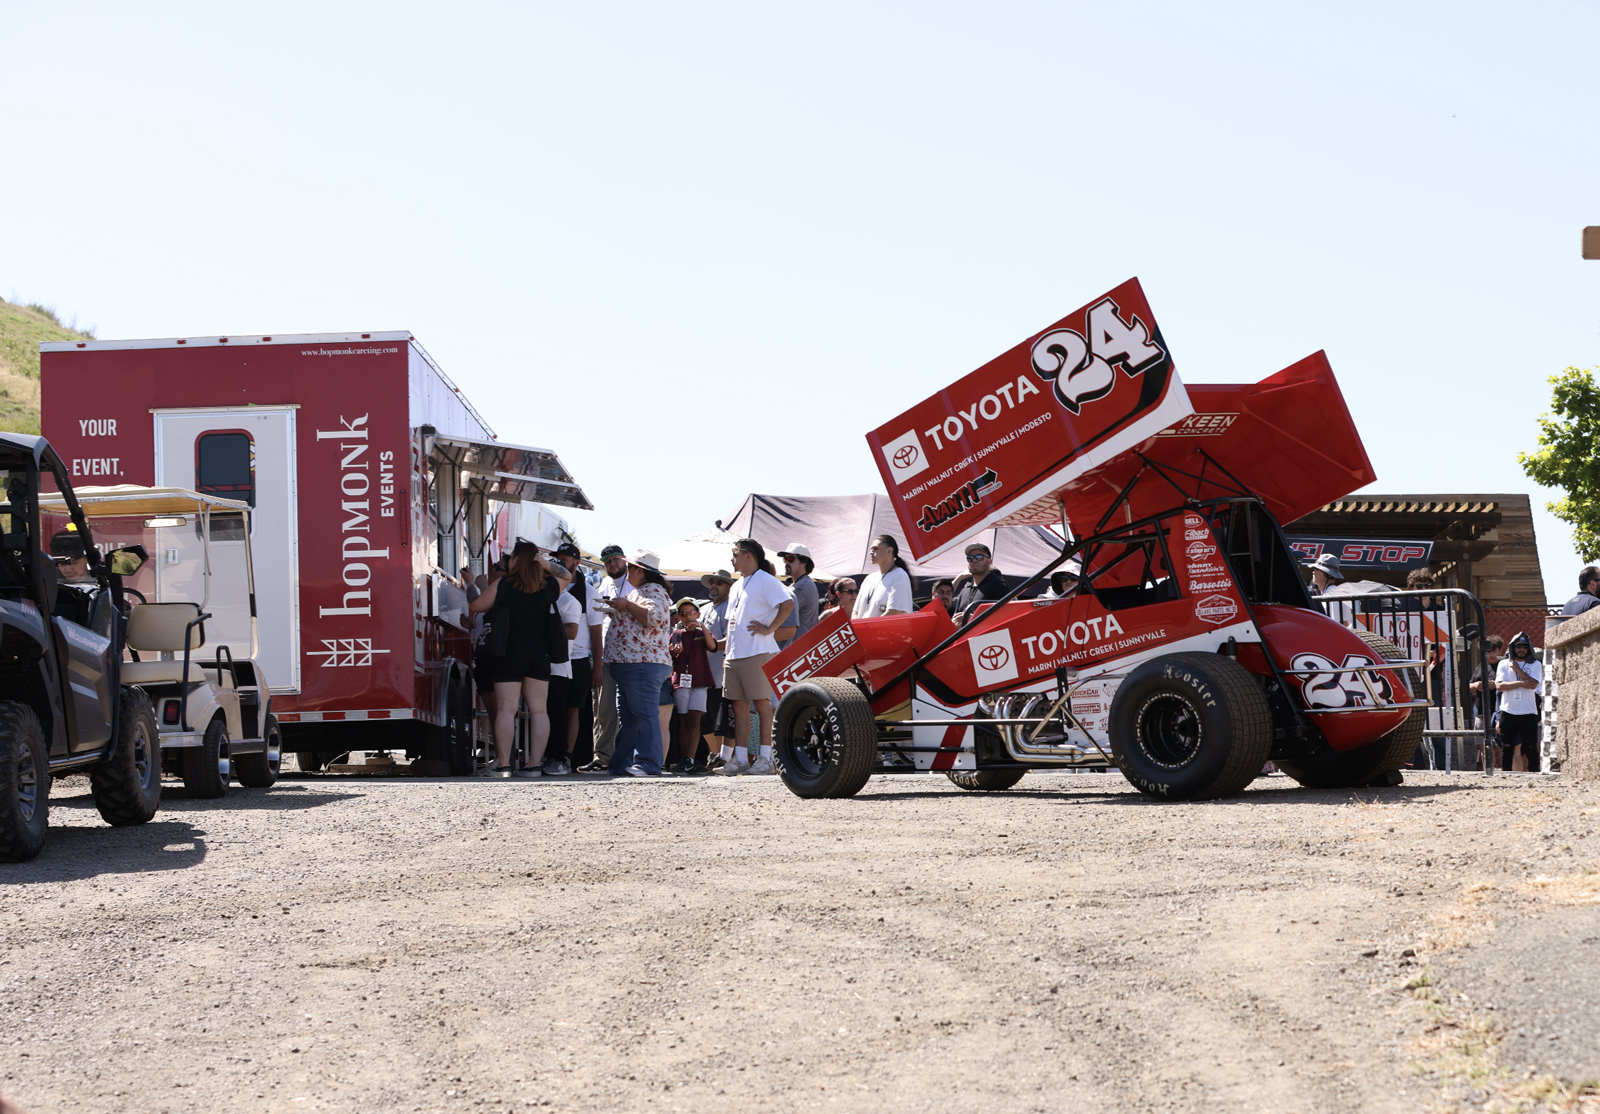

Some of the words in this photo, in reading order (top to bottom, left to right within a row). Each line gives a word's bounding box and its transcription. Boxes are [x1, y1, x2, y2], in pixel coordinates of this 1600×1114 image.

[1031, 296, 1166, 416] 24
[79, 418, 118, 437] YOUR
[925, 374, 1040, 451] TOYOTA
[1182, 415, 1238, 428] KEEN
[72, 458, 124, 476] EVENT,
[902, 485, 924, 501] MARIN
[926, 468, 954, 487] WALNUT
[953, 456, 974, 472] CREEK
[977, 434, 1016, 459] SUNNYVALE
[1018, 412, 1052, 434] MODESTO
[380, 450, 395, 518] EVENTS
[922, 481, 981, 531] AVANTI
[1340, 544, 1426, 563] STOP
[805, 624, 854, 666] KEEN
[811, 634, 857, 670] CONCRETE
[1021, 613, 1125, 660] TOYOTA
[1028, 661, 1053, 675] MARIN
[1057, 651, 1088, 665] WALNUT
[1089, 643, 1115, 657] CREEK
[1118, 629, 1167, 649] SUNNYVALE
[1163, 664, 1216, 707] Hoosier
[1290, 652, 1399, 716] 24
[823, 702, 844, 766] Hoosier
